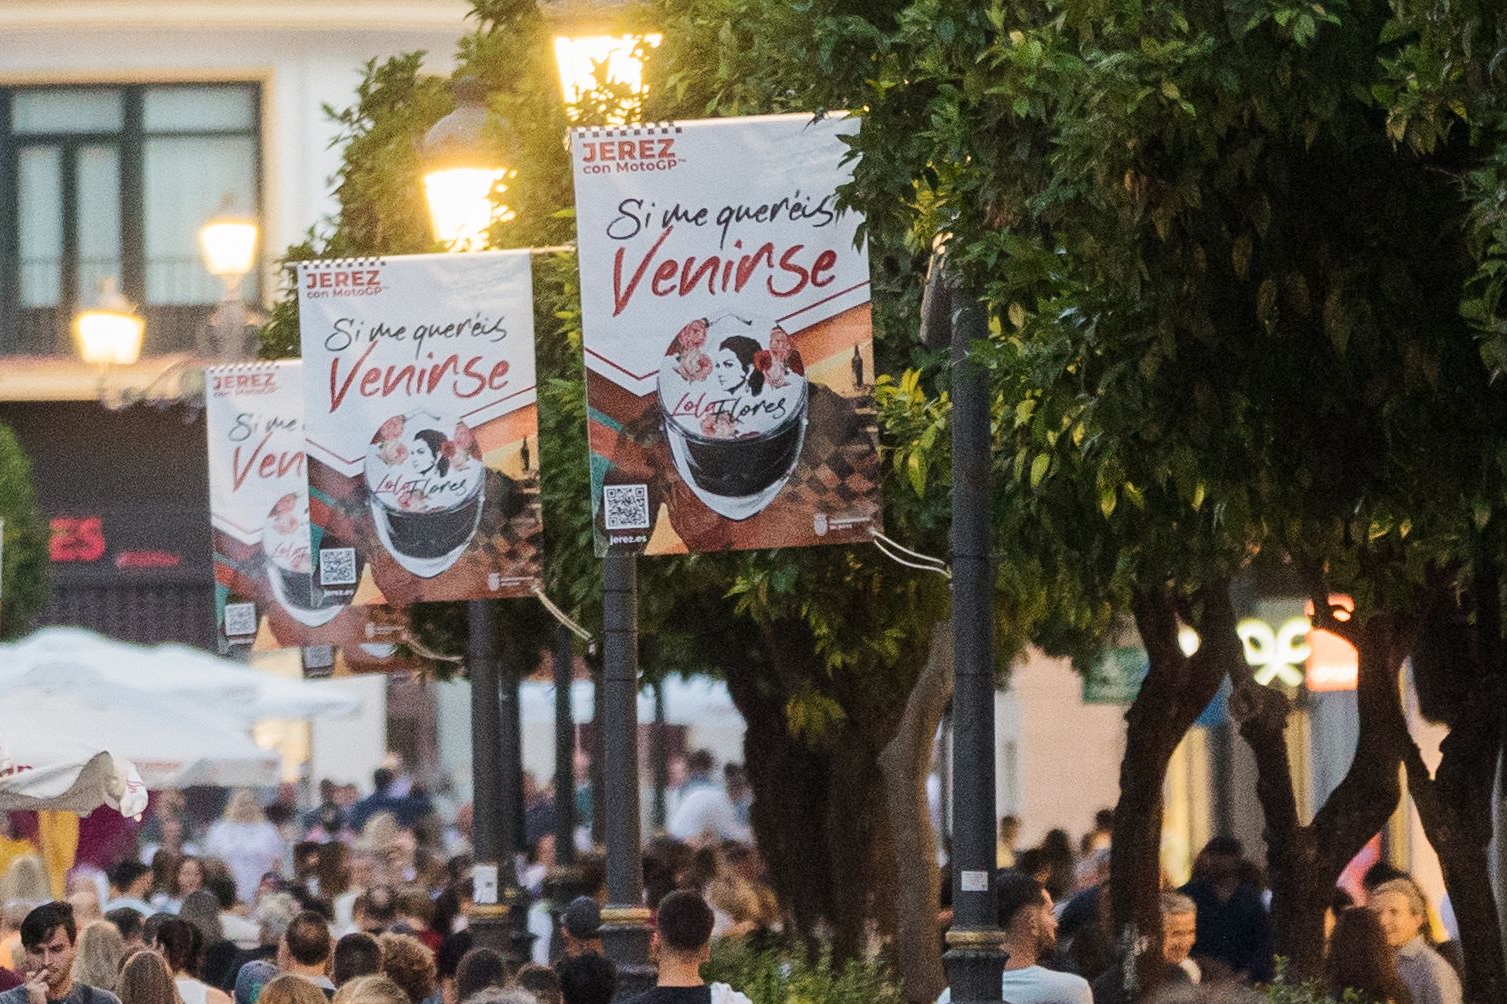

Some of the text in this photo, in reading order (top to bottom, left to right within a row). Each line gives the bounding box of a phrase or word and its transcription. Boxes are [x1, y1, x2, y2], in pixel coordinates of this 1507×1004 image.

[582, 138, 676, 162] JEREZ
[583, 162, 611, 174] con
[607, 190, 836, 250] Si me queréis
[306, 270, 381, 289] JEREZ
[613, 225, 838, 317] Venirse
[307, 289, 329, 299] con
[325, 312, 507, 360] Si me queréis
[213, 372, 276, 390] JEREZ
[329, 340, 510, 413] Venirse
[672, 391, 787, 425] Lola Flores
[228, 412, 297, 441] Si me
[232, 431, 305, 493] Ven
[377, 474, 468, 499] Lola Flores
[609, 534, 648, 546] jerez.es
